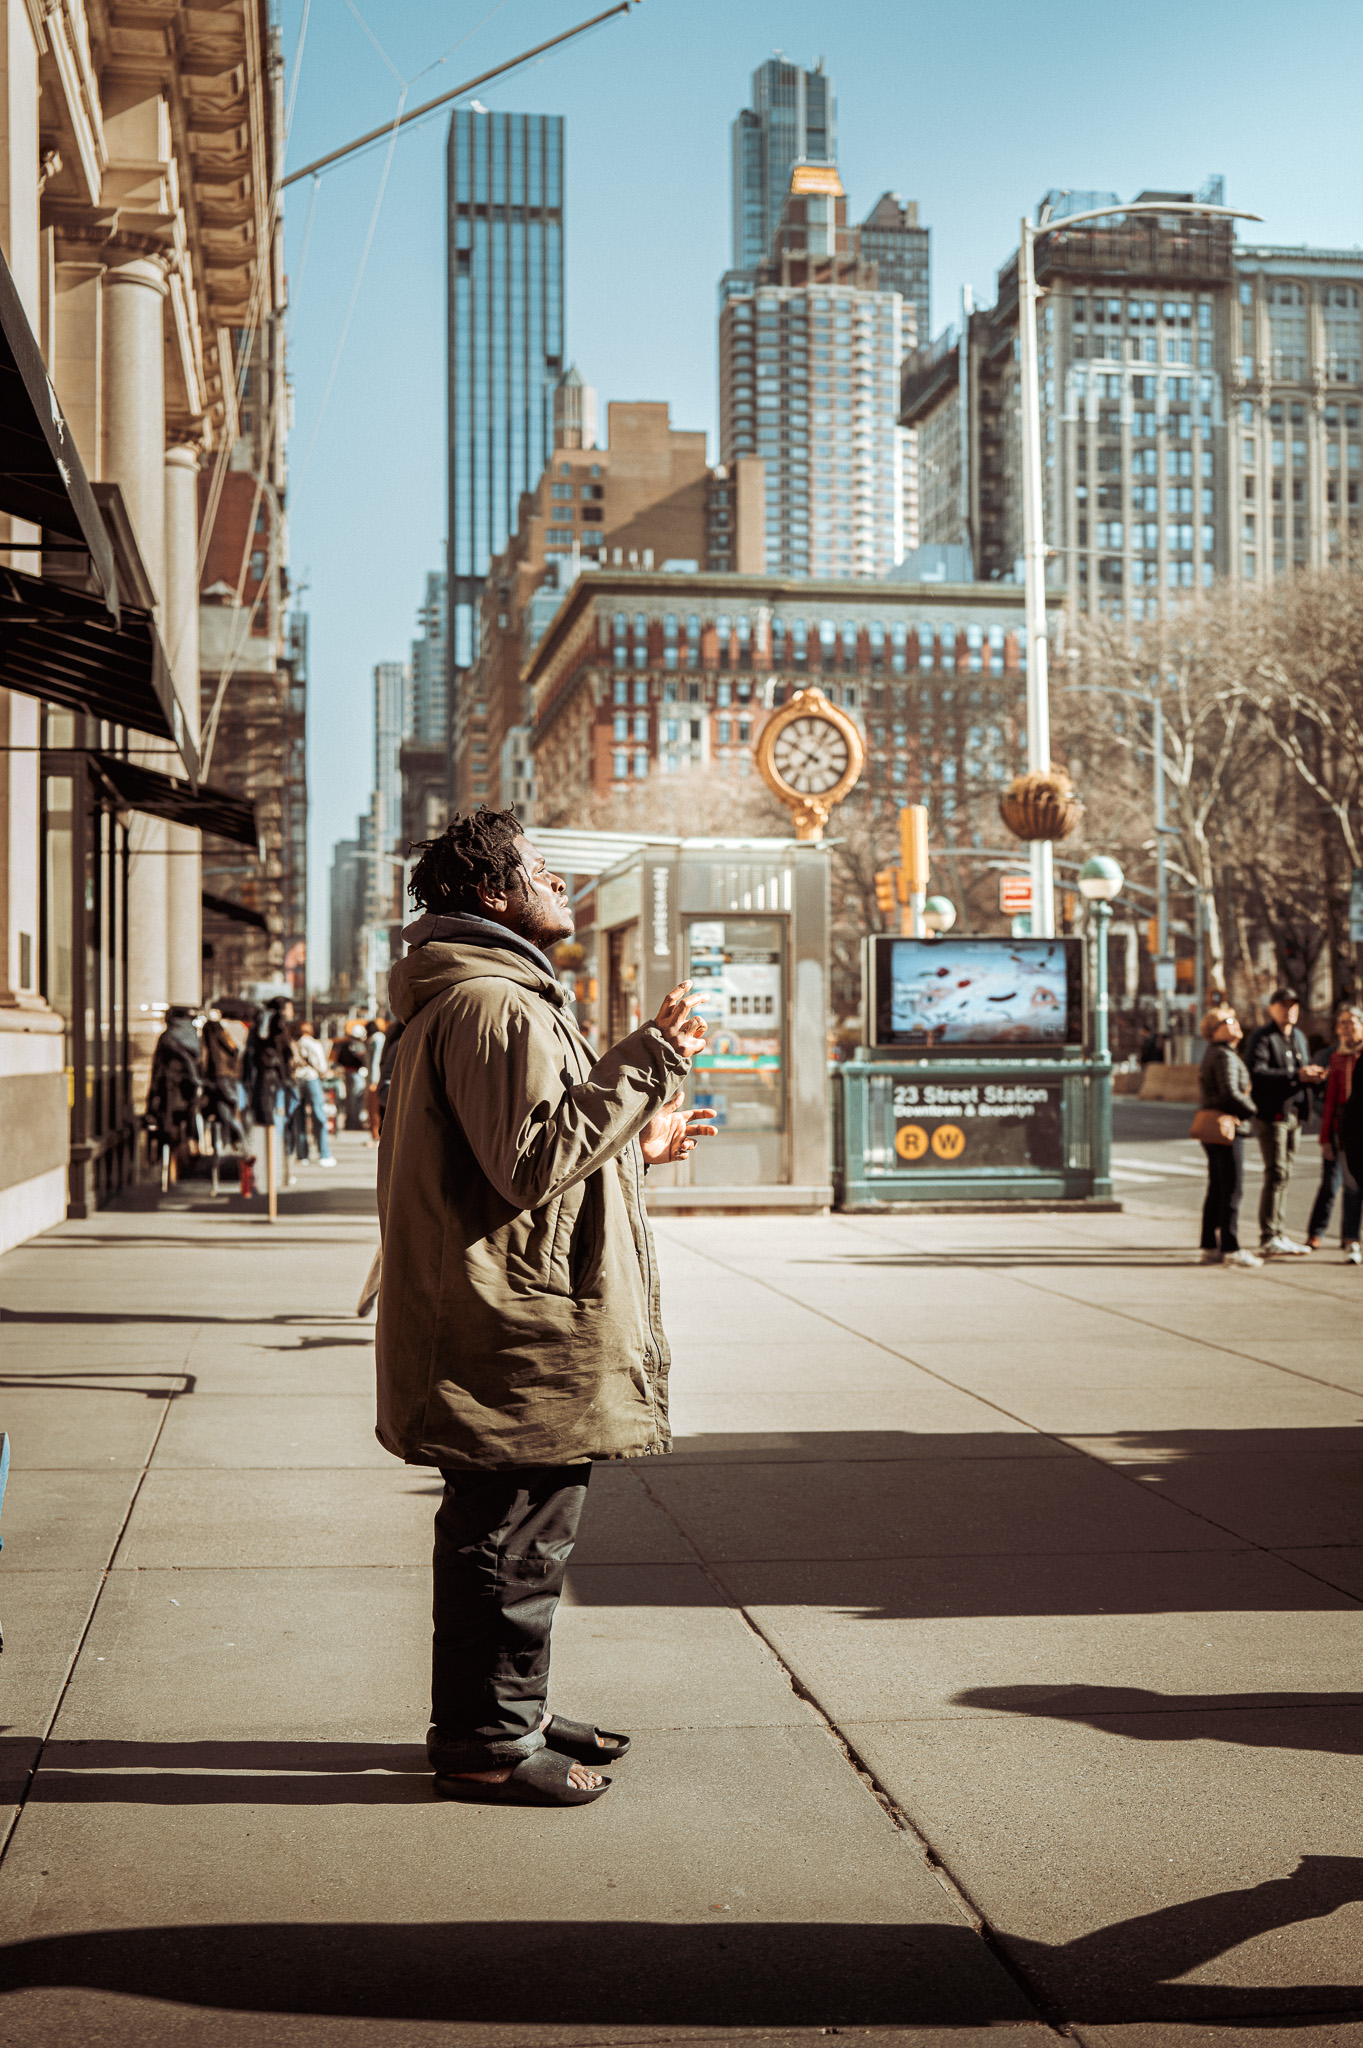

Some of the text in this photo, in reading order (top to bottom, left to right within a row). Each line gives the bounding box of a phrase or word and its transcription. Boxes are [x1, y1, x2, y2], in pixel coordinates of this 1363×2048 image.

[894, 1085, 1048, 1104] 23 Street Station
[893, 1103, 963, 1118] Downtown
[977, 1103, 1036, 1119] Brooklyn
[904, 1133, 959, 1151] R W
